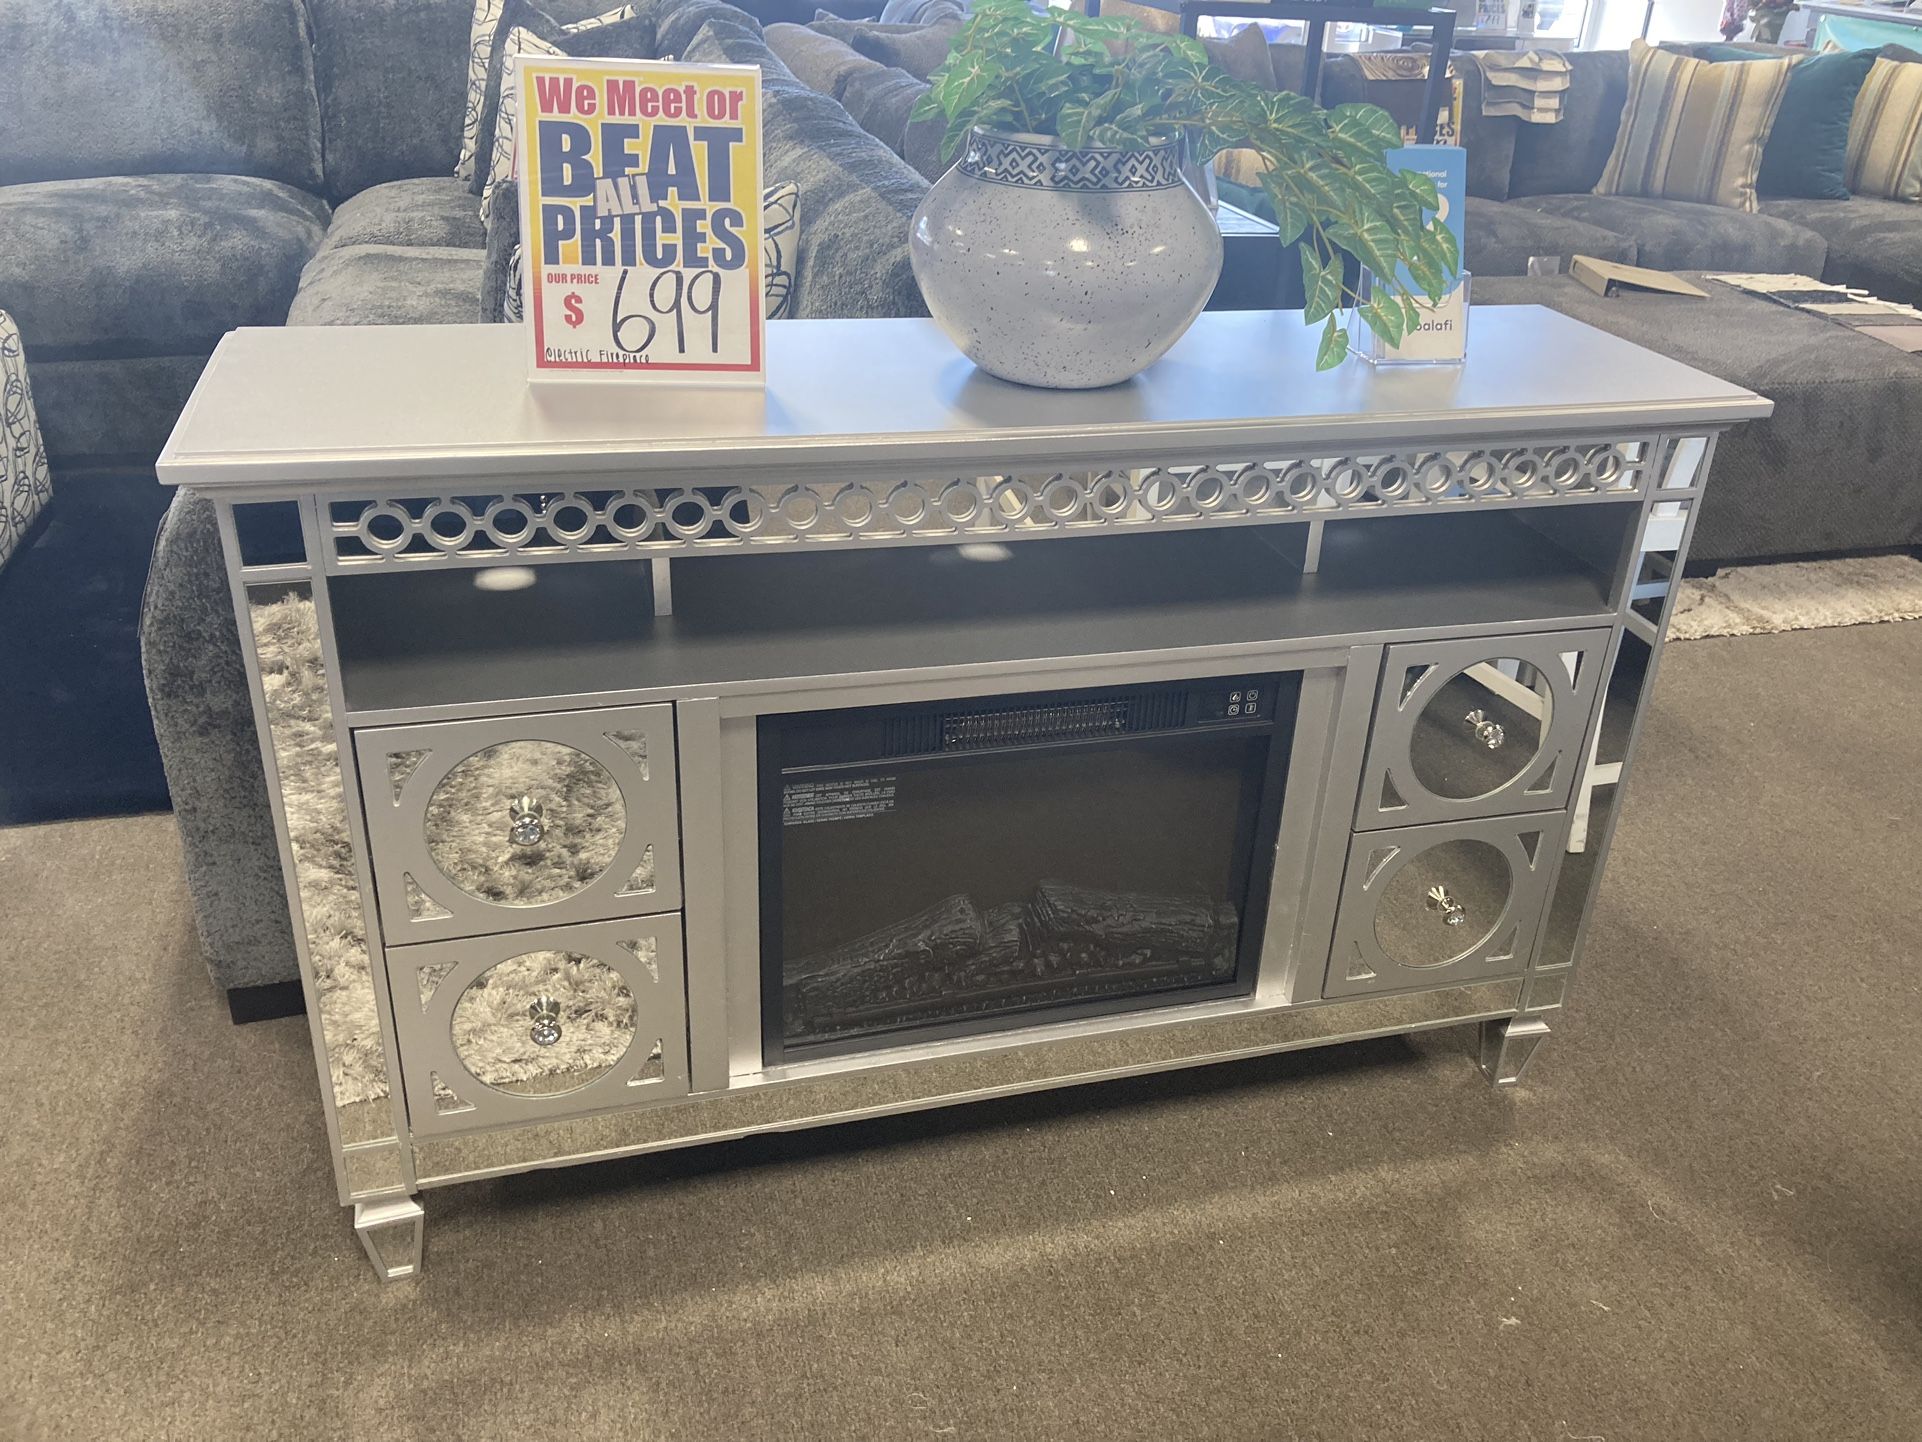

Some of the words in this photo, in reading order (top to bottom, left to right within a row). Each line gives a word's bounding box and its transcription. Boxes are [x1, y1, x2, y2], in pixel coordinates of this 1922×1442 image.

[535, 76, 596, 115] We
[606, 79, 697, 119] Meet
[706, 89, 743, 120] or
[538, 120, 743, 203] BEAT
[595, 174, 658, 216] ALL
[542, 204, 746, 270] PRICES
[547, 273, 569, 285] OUR
[570, 273, 600, 285] PRICE
[563, 291, 584, 329] $
[611, 268, 722, 354] 699
